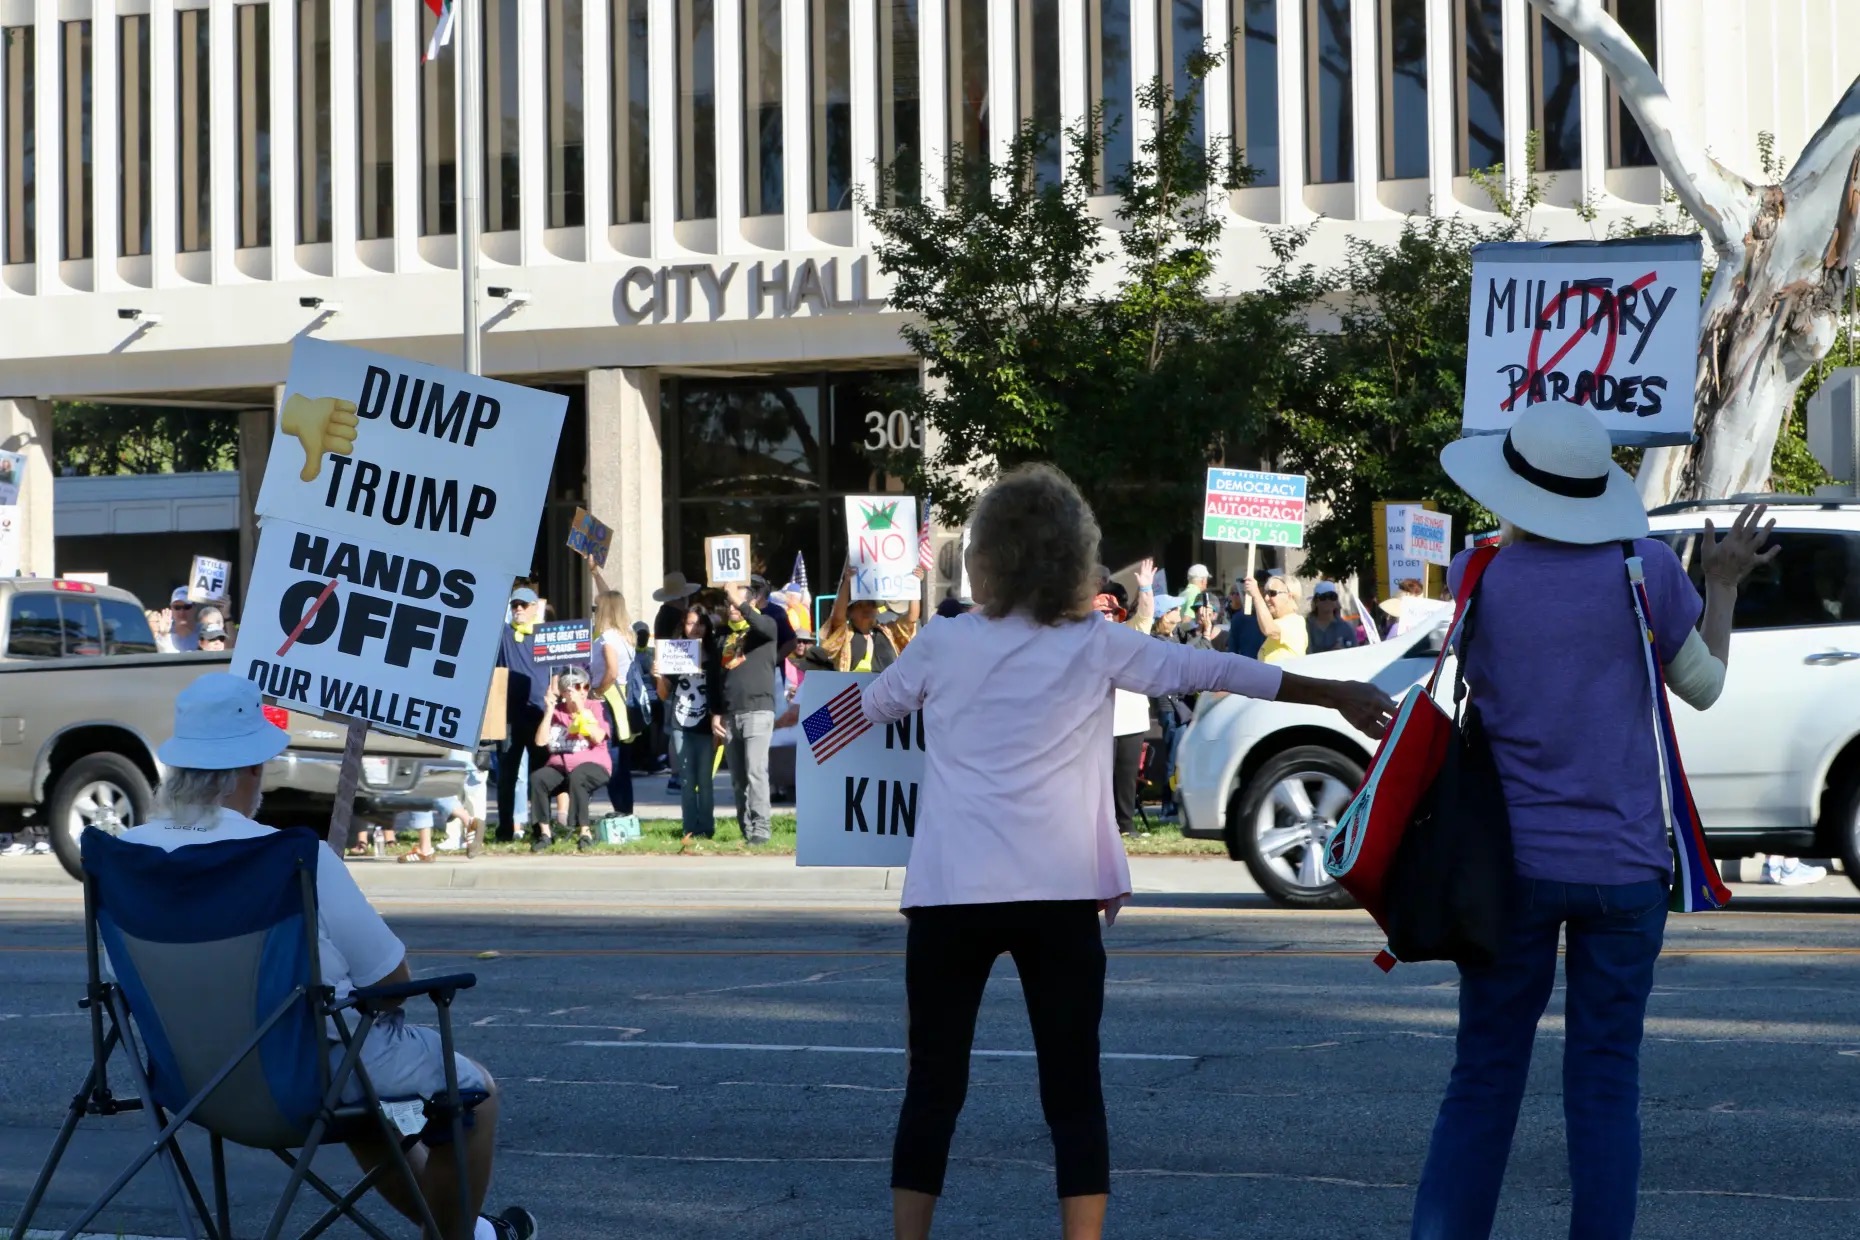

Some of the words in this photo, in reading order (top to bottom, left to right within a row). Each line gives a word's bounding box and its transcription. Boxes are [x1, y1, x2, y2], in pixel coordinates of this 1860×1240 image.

[618, 261, 740, 320] CITY
[756, 255, 890, 315] HALL
[1485, 276, 1678, 365] MILITARY
[357, 364, 501, 448] DUMP
[1497, 363, 1668, 417] PARADES
[325, 453, 497, 538] TRUMP
[1216, 479, 1296, 496] DEMOCRACY
[1207, 502, 1303, 521] AUTOCRACY
[859, 534, 905, 564] NO
[1217, 525, 1261, 541] PROP
[1269, 529, 1289, 543] 50
[201, 560, 224, 570] STILL
[289, 532, 477, 609] HANDS
[717, 548, 741, 571] YES
[196, 576, 223, 592] AF
[855, 568, 918, 596] Kings
[278, 579, 469, 679] OFF!
[247, 659, 312, 704] OUR
[320, 676, 462, 740] WALLETS
